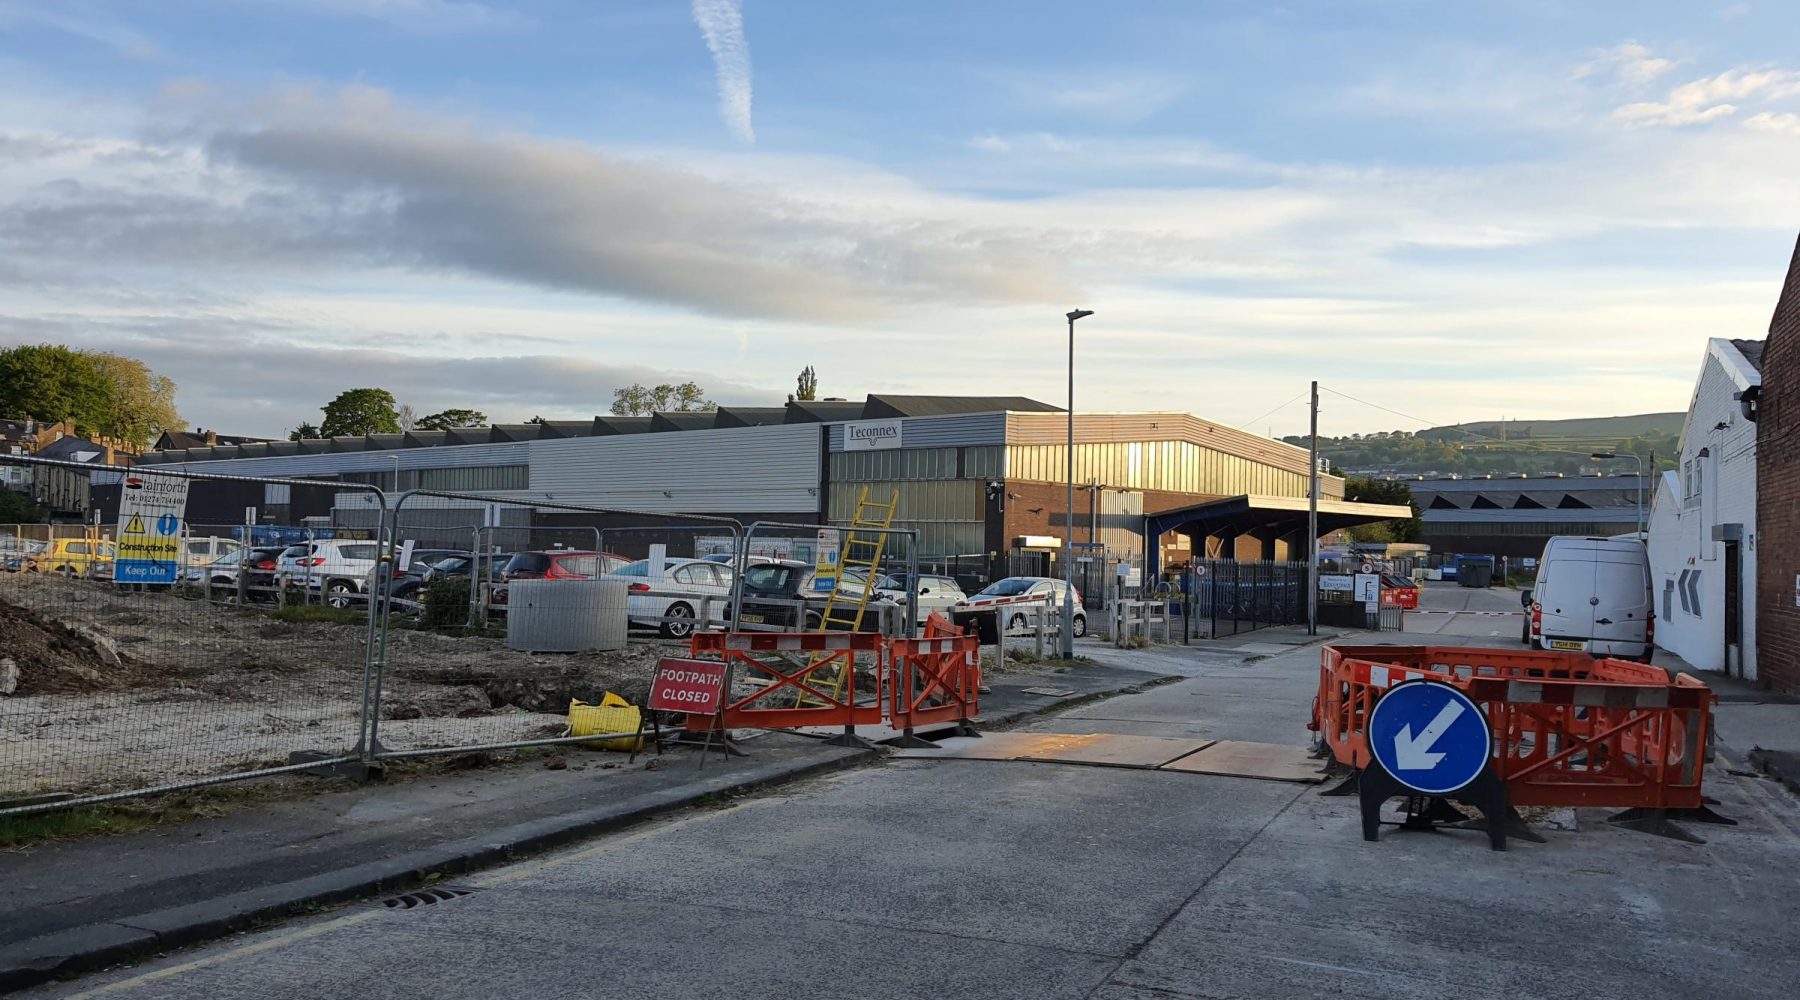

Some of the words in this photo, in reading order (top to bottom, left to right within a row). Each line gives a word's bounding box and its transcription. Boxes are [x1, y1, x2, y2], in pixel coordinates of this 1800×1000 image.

[849, 425, 898, 438] Teconnex
[124, 494, 138, 502] Tel:
[139, 494, 159, 503] 01274
[119, 542, 164, 552] Construction
[164, 543, 178, 553] Site
[125, 565, 147, 577] Keep
[149, 566, 166, 576] Out
[660, 669, 721, 685] FOOTPATH
[662, 688, 710, 703] CLOSED
